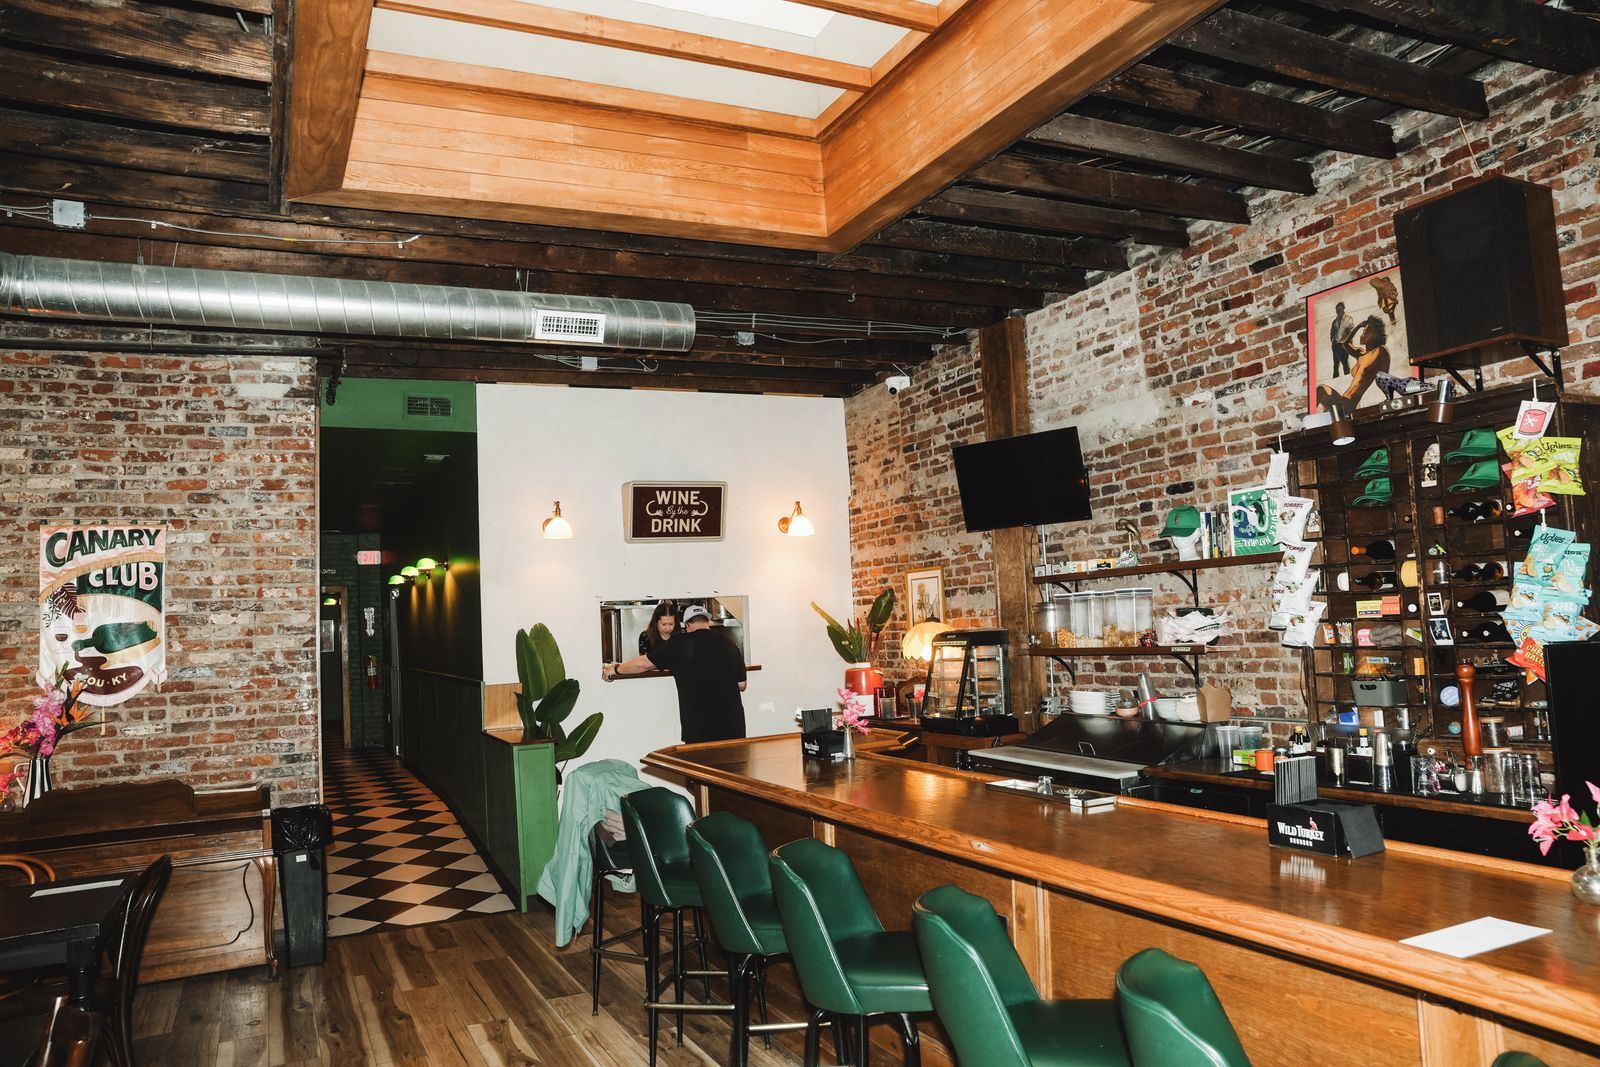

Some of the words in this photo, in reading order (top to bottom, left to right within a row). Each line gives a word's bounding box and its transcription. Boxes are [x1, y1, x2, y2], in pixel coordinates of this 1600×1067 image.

[655, 490, 700, 505] WINE
[677, 505, 689, 515] the
[651, 518, 702, 533] DRINK
[1242, 536, 1271, 547] NATURAL
[1540, 532, 1565, 545] Uglies
[46, 528, 161, 567] CANARY
[360, 551, 378, 564] EXIT
[88, 562, 159, 591] CLUB
[84, 675, 105, 687] OU
[111, 672, 128, 686] KY
[1277, 821, 1297, 837] WILD
[1296, 824, 1325, 841] TURKEY
